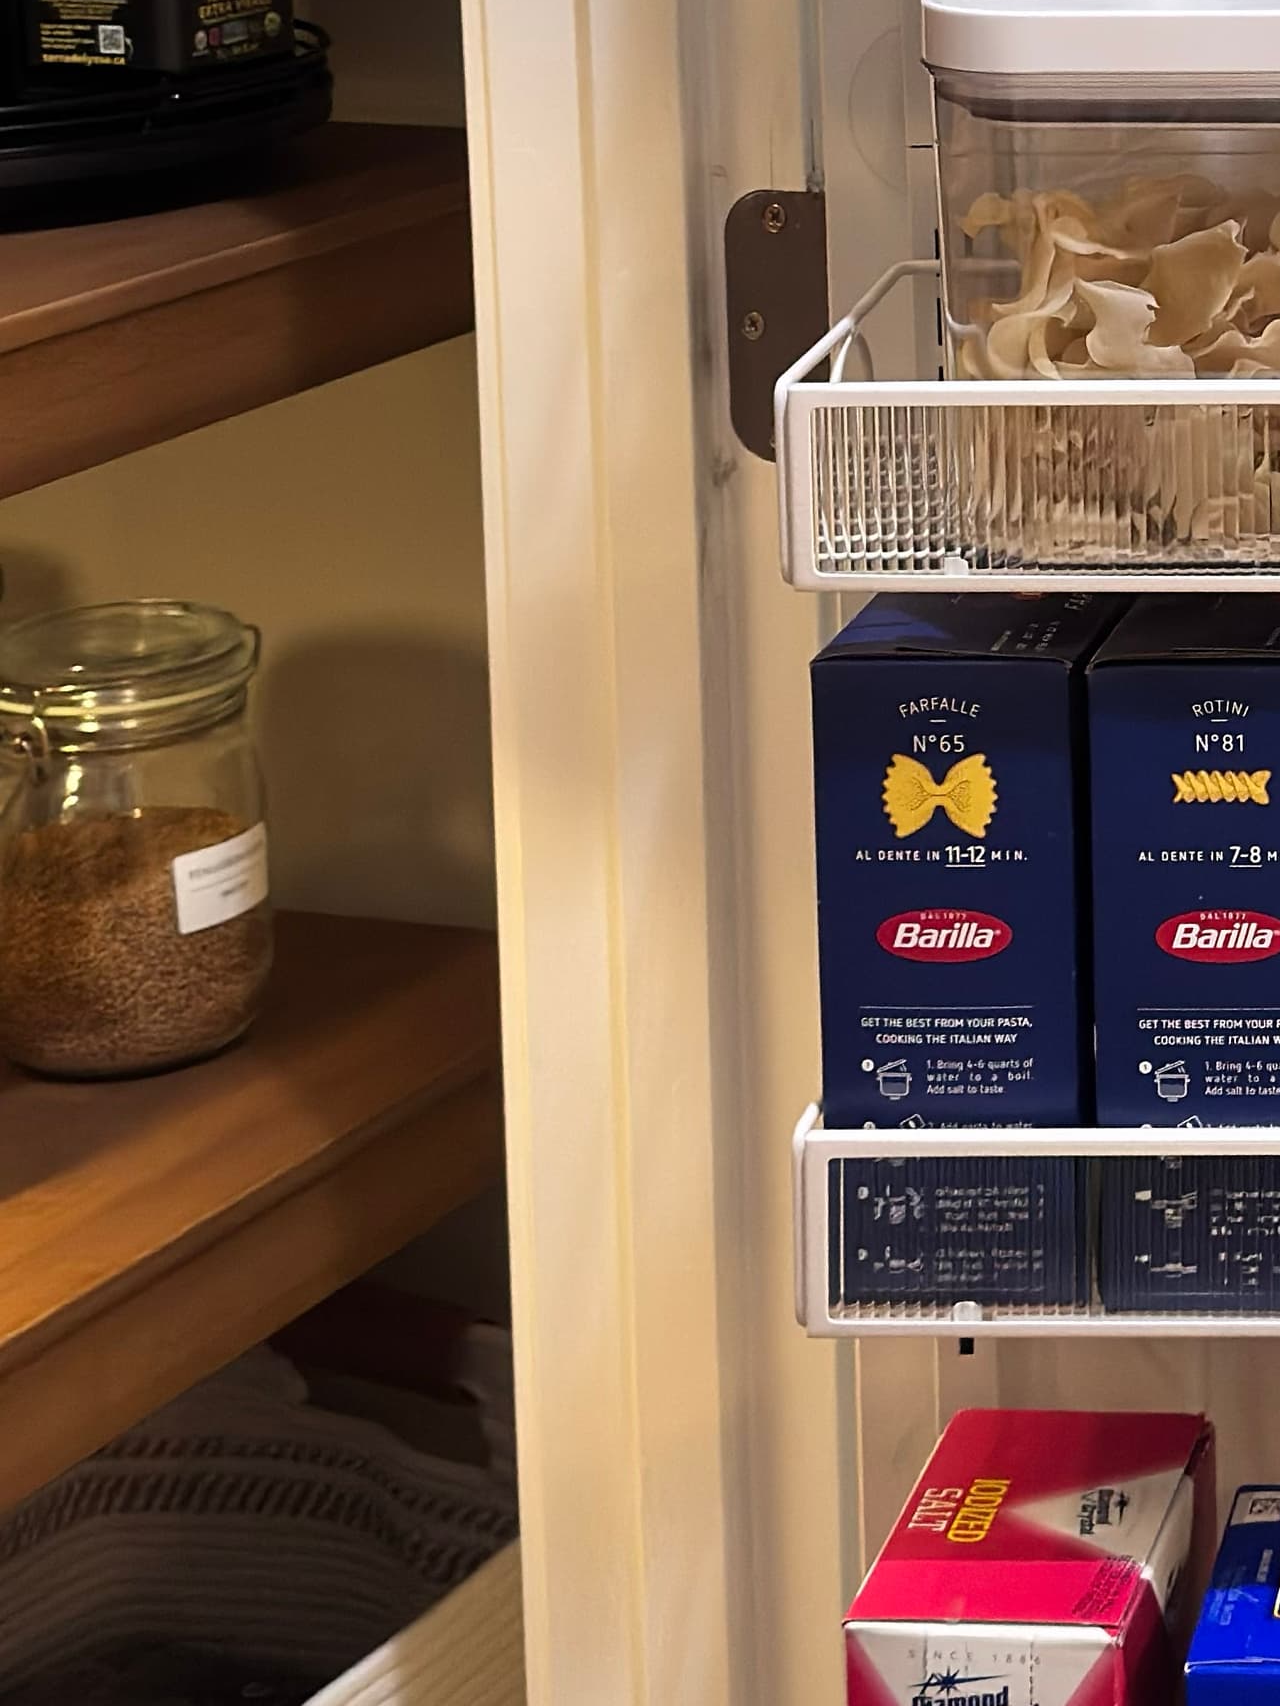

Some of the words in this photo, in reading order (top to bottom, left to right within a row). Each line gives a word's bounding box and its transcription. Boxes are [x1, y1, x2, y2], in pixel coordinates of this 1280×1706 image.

[899, 697, 981, 719] FARFALLE
[1192, 699, 1249, 718] ROTINI
[913, 735, 964, 753] N°65
[1195, 734, 1244, 752] N°81
[855, 850, 871, 861] AL
[878, 850, 920, 861] DENTE
[926, 850, 940, 861] IN
[945, 846, 986, 863] 11-12
[991, 850, 1028, 861] MIN.
[893, 922, 994, 948] Barilla
[1172, 922, 1274, 949] Barilla
[1139, 1019, 1158, 1029] GET
[1161, 1019, 1180, 1029] THE
[1184, 1019, 1210, 1029] BEST
[1213, 1019, 1242, 1029] FROM
[1245, 1019, 1273, 1029] YOUR
[1154, 1036, 1201, 1045] COOKING
[1205, 1036, 1224, 1045] THE
[1228, 1036, 1269, 1045] ITALIAN
[908, 1487, 964, 1532] SALT
[947, 1478, 1011, 1543] IODIZED
